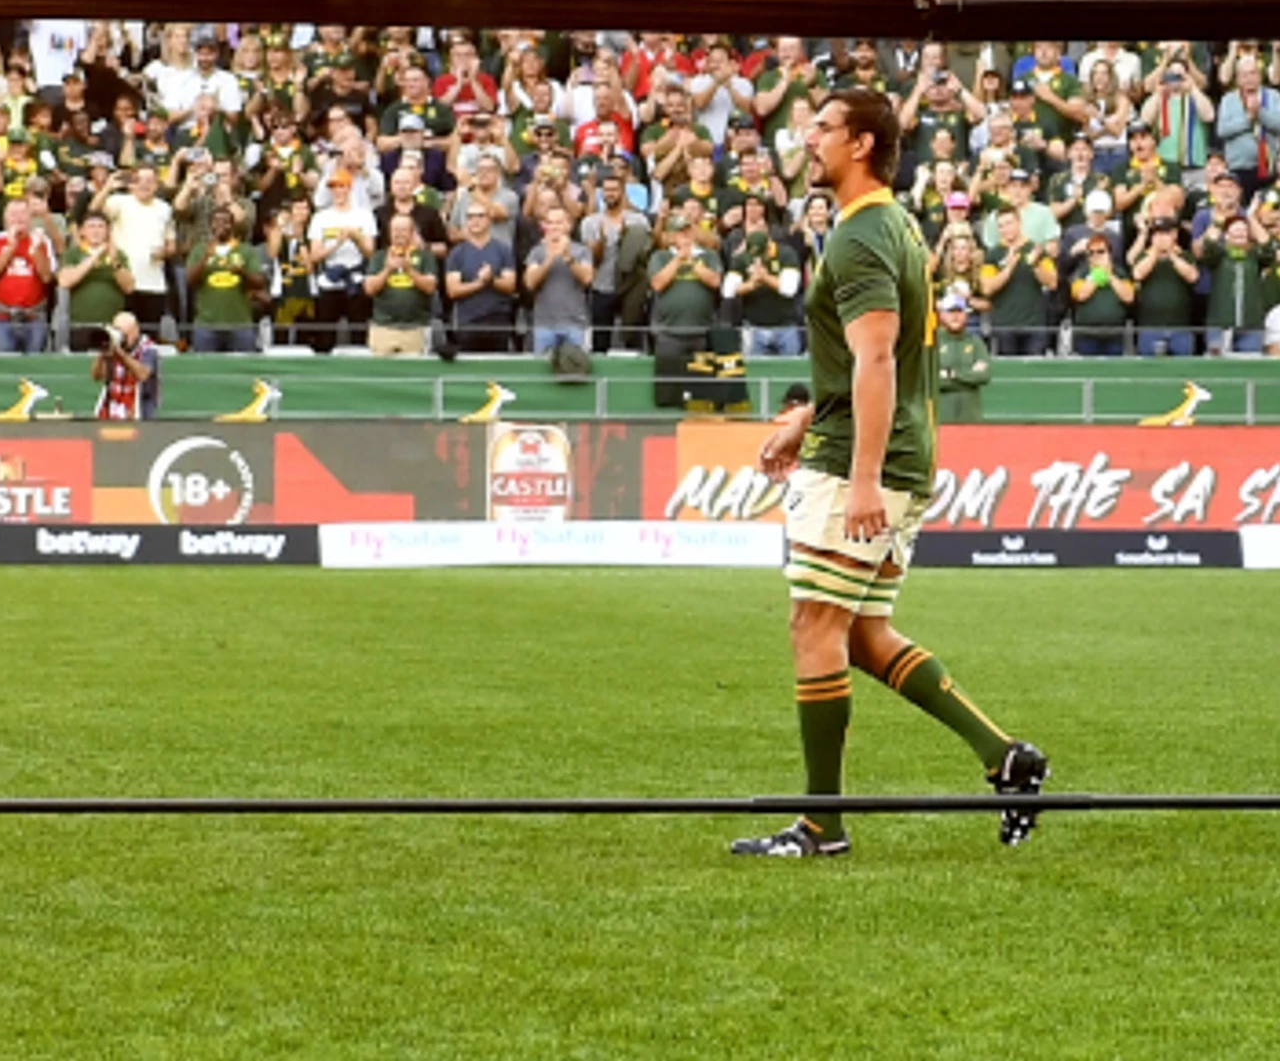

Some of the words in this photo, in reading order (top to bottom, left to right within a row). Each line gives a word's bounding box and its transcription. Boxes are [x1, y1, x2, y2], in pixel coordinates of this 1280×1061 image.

[167, 472, 232, 507] 18+
[492, 476, 567, 497] CASTLE
[664, 465, 786, 519] MAD
[1026, 451, 1132, 529] THE
[1142, 461, 1217, 524] SA
[36, 527, 141, 560] betway
[179, 529, 287, 560] betway
